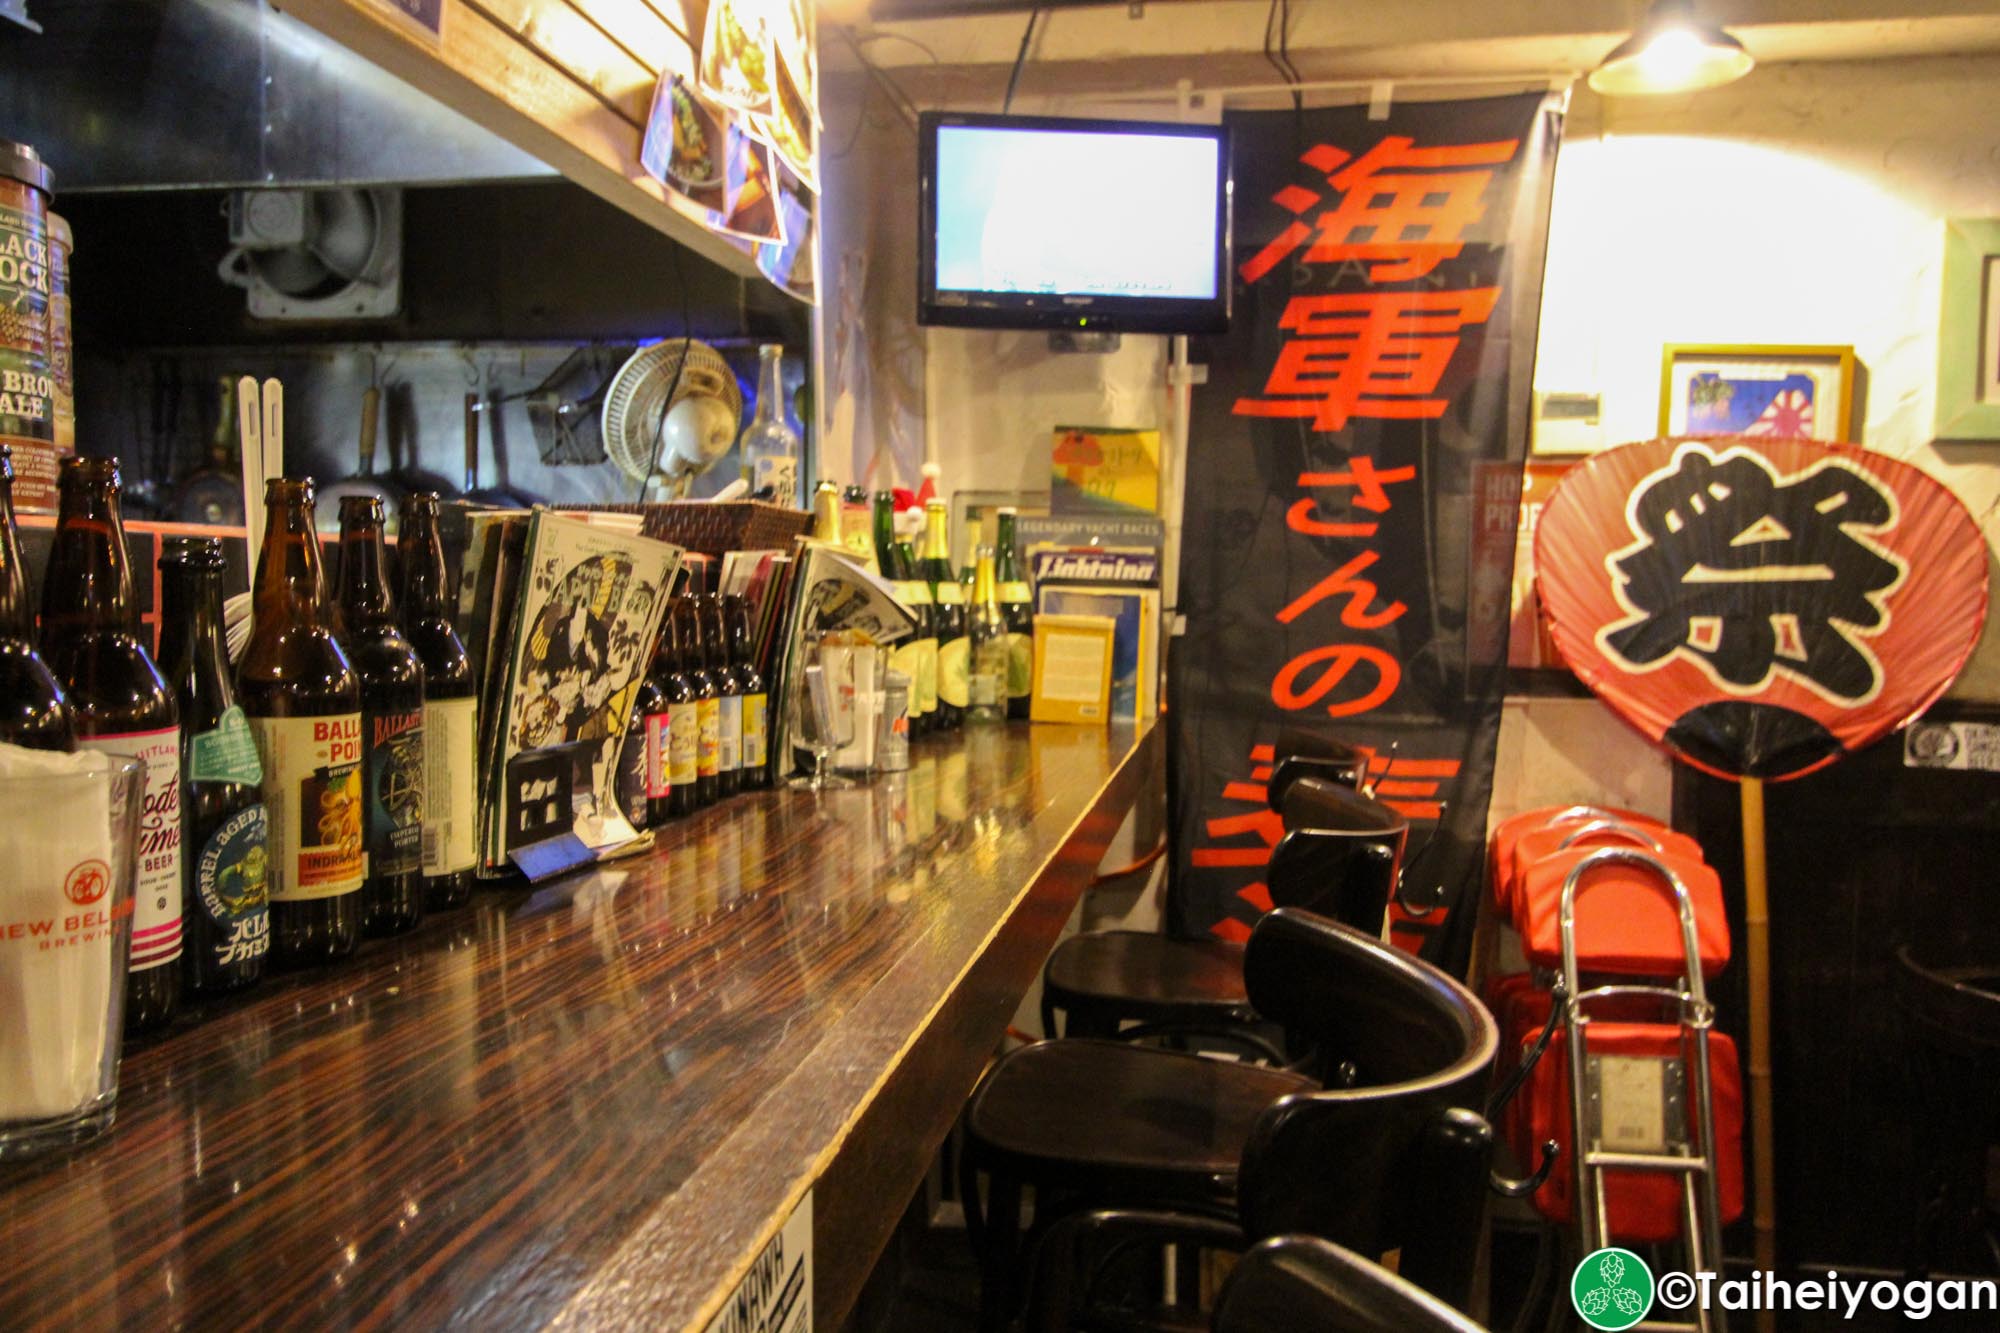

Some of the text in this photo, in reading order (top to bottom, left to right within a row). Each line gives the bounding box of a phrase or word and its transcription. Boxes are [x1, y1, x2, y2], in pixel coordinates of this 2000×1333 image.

[0, 232, 47, 268] ACK
[0, 392, 44, 420] ALE
[1016, 521, 1159, 536] LEGENDARY YACHT RACES
[145, 853, 173, 872] BEER
